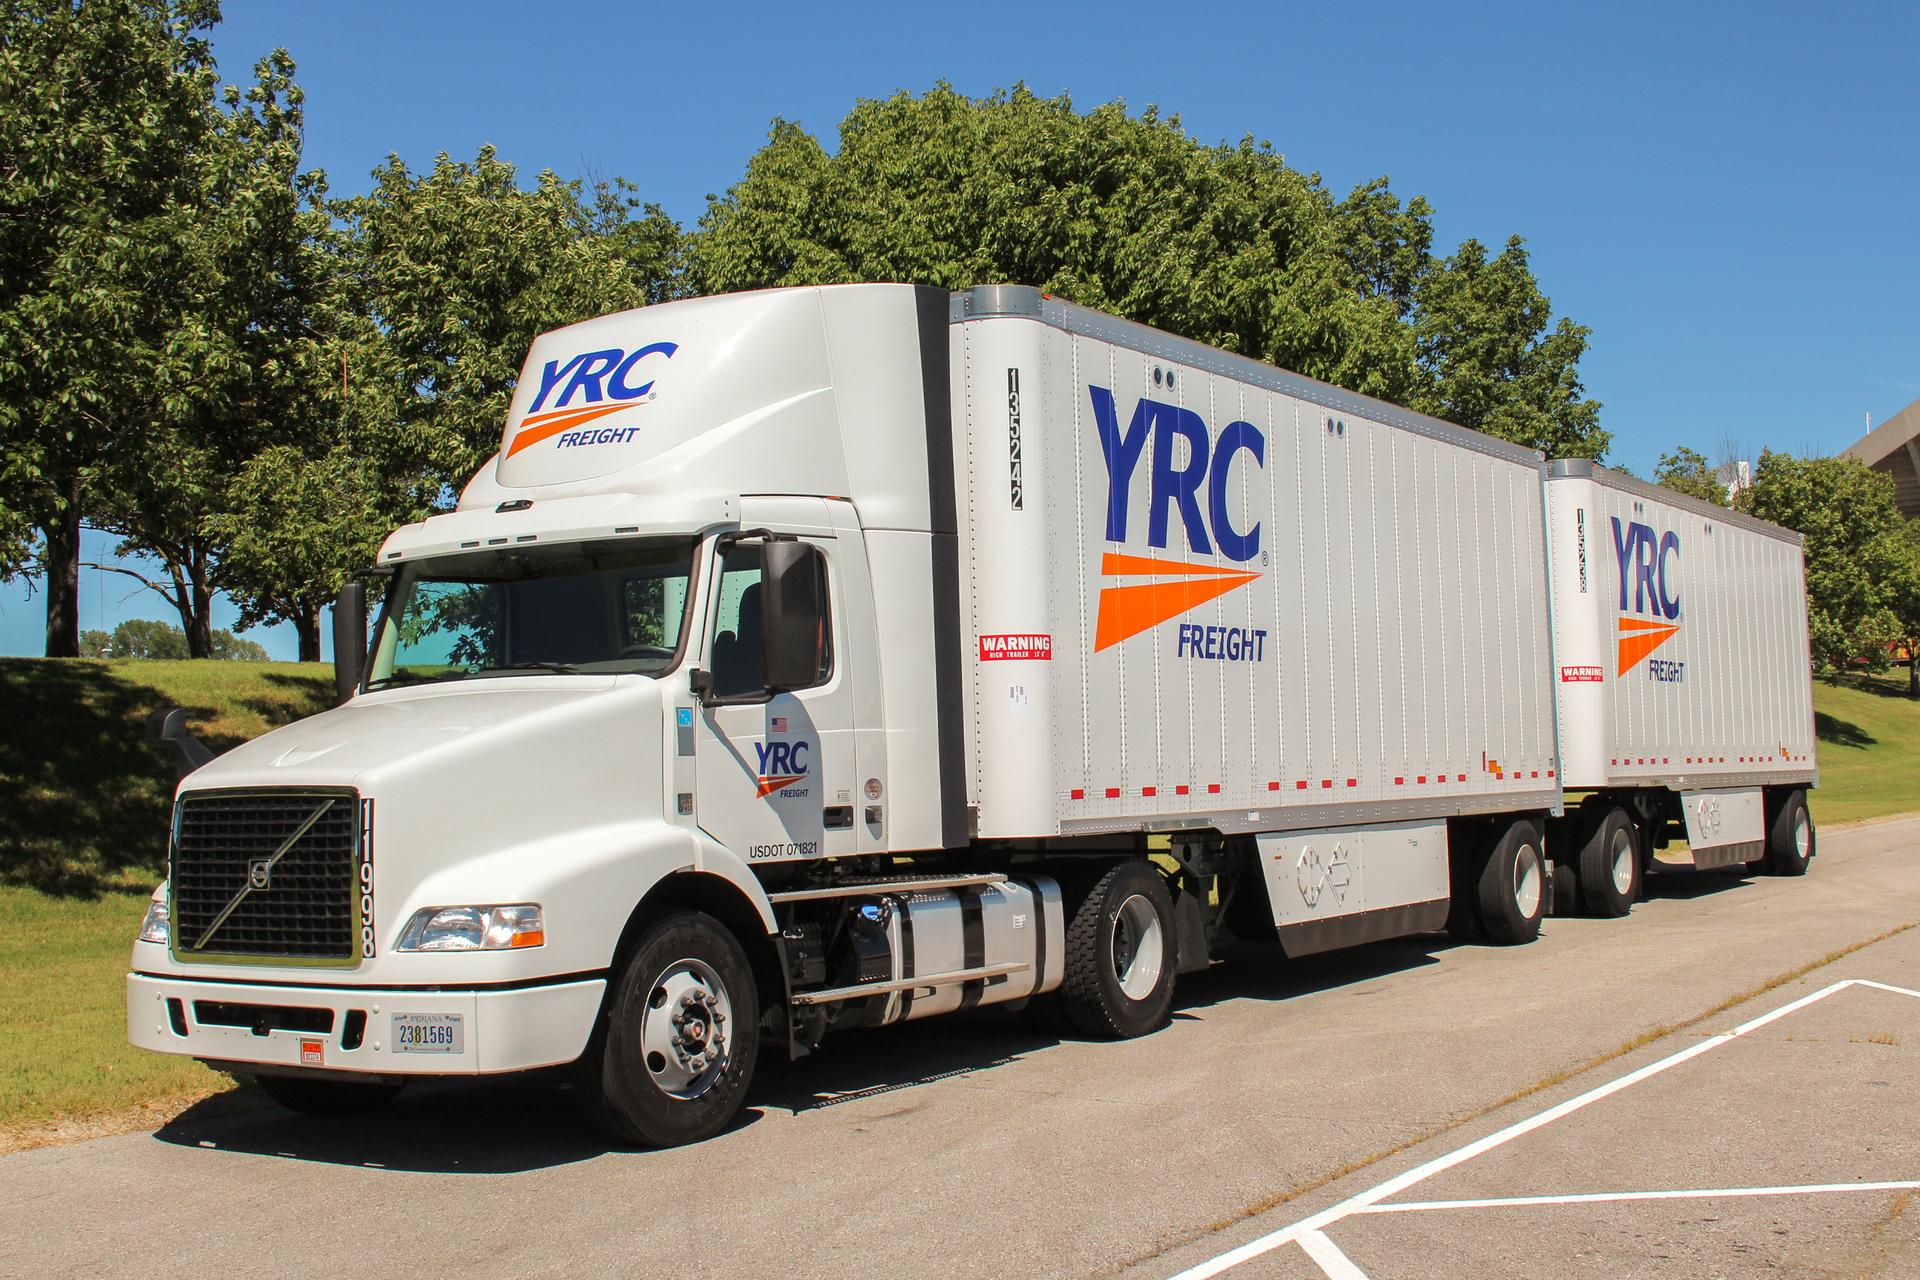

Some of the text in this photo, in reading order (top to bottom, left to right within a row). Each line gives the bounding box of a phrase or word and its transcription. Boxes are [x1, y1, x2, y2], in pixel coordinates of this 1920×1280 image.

[527, 341, 679, 415] YRC
[556, 427, 641, 449] FREIGHT
[1009, 368, 1022, 511] 135242
[1088, 384, 1265, 562] YRC
[1610, 516, 1680, 620] YRC
[982, 636, 1050, 651] WARNING
[1178, 623, 1268, 662] FREIGHT
[1649, 659, 1685, 683] FREIGHT
[754, 741, 809, 775] YRC
[780, 788, 809, 798] FREIGHT
[749, 841, 818, 859] USDOT 071821
[360, 798, 375, 958] 11998
[410, 1015, 443, 1023] INDIANA
[399, 1025, 453, 1044] 2381569
